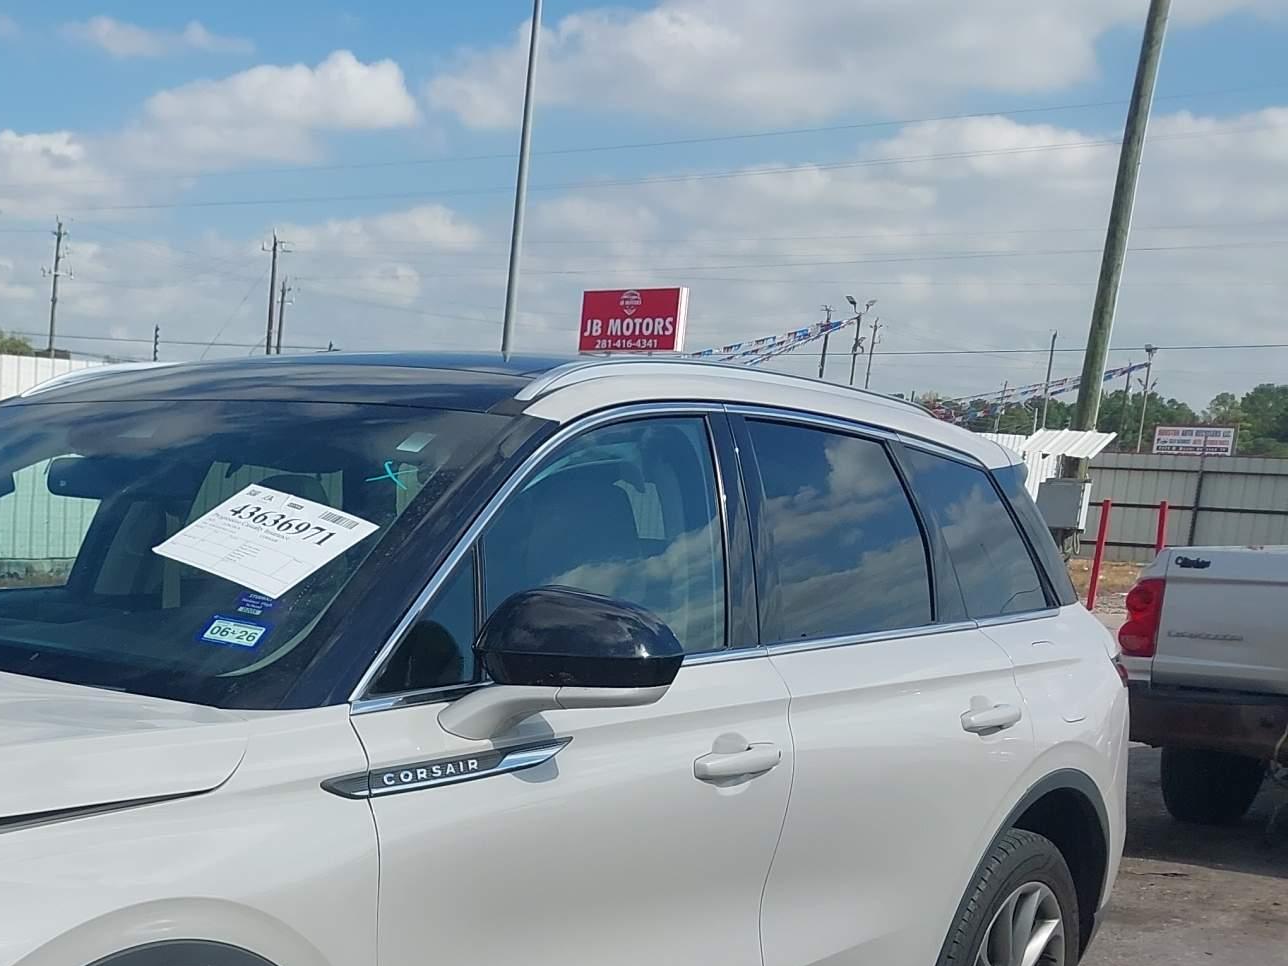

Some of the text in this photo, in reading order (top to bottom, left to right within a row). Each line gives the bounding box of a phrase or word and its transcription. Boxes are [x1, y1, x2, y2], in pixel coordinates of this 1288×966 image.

[584, 318, 673, 336] JB MOTORS
[596, 340, 657, 348] 281-416-4341
[230, 504, 336, 546] 43636971
[383, 759, 479, 785] CORSAIR
